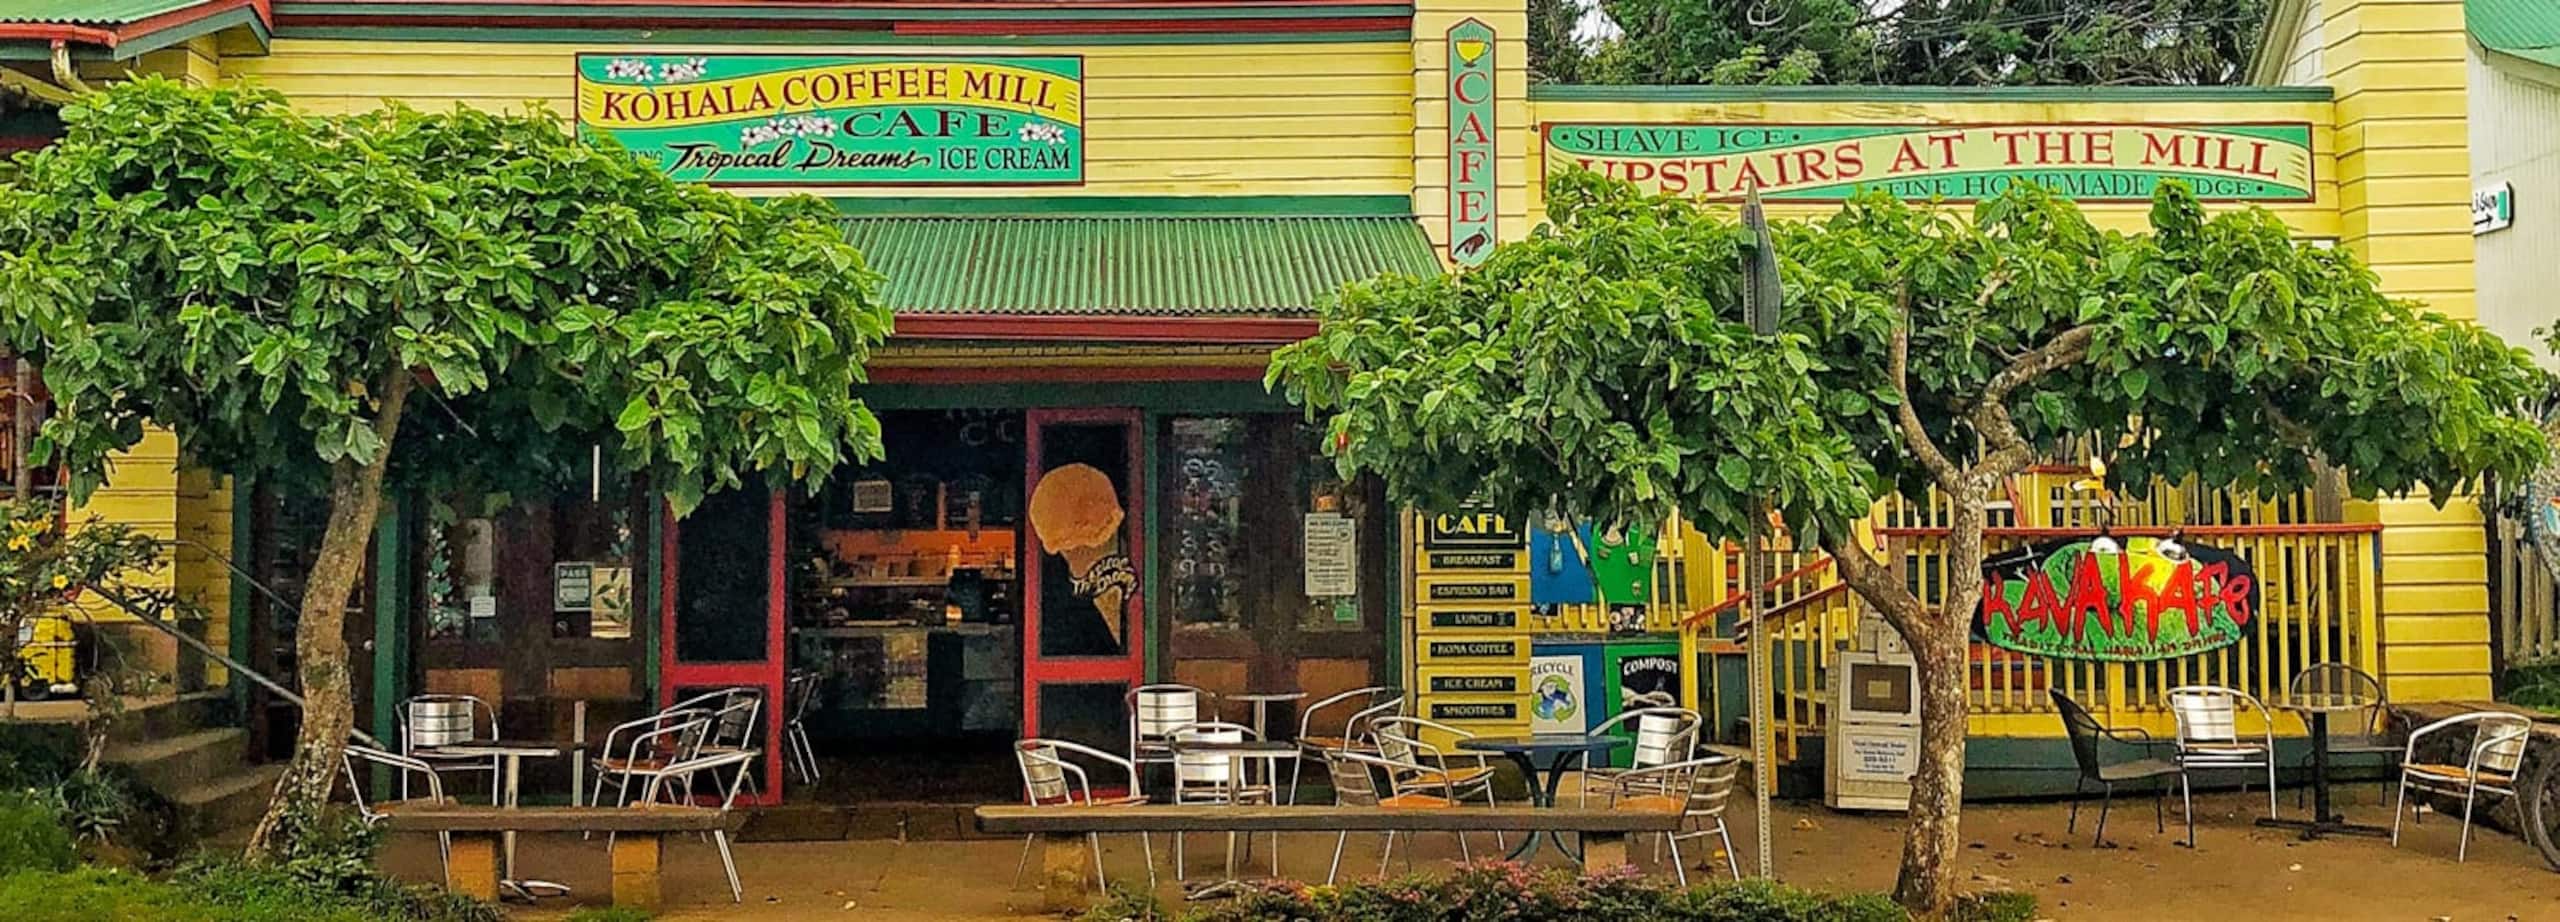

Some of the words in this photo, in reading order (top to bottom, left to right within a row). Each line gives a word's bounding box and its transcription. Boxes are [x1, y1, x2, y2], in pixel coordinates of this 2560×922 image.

[600, 81, 774, 122] KOHALA
[783, 68, 948, 106] COFFEE
[961, 70, 1057, 111] MILL
[843, 109, 1011, 138] CAFE
[1454, 71, 1489, 223] CAFE
[1575, 129, 1699, 152] SHAVE
[1718, 129, 1786, 149] ICE
[664, 139, 793, 180] Tropical
[791, 139, 931, 172] Dreams
[938, 147, 979, 169] ICE
[985, 147, 1070, 170] CREAM
[1888, 130, 1966, 173] AT
[1993, 129, 2114, 166] THE
[2140, 132, 2278, 180] MILL
[1887, 177, 1954, 197] FINE
[1442, 555, 1502, 566] BREAKFAST
[1488, 586, 1508, 596] BAR
[1982, 550, 2114, 643] KAVA
[1454, 614, 1493, 625] LUNCH
[1437, 644, 1467, 654] KONA
[1468, 644, 1508, 654] COFFEE
[1623, 656, 1678, 676] COMPOST
[1444, 679, 1462, 689] ICE
[1464, 679, 1504, 689] CREAM
[1442, 706, 1506, 716] SMOOTHIES
